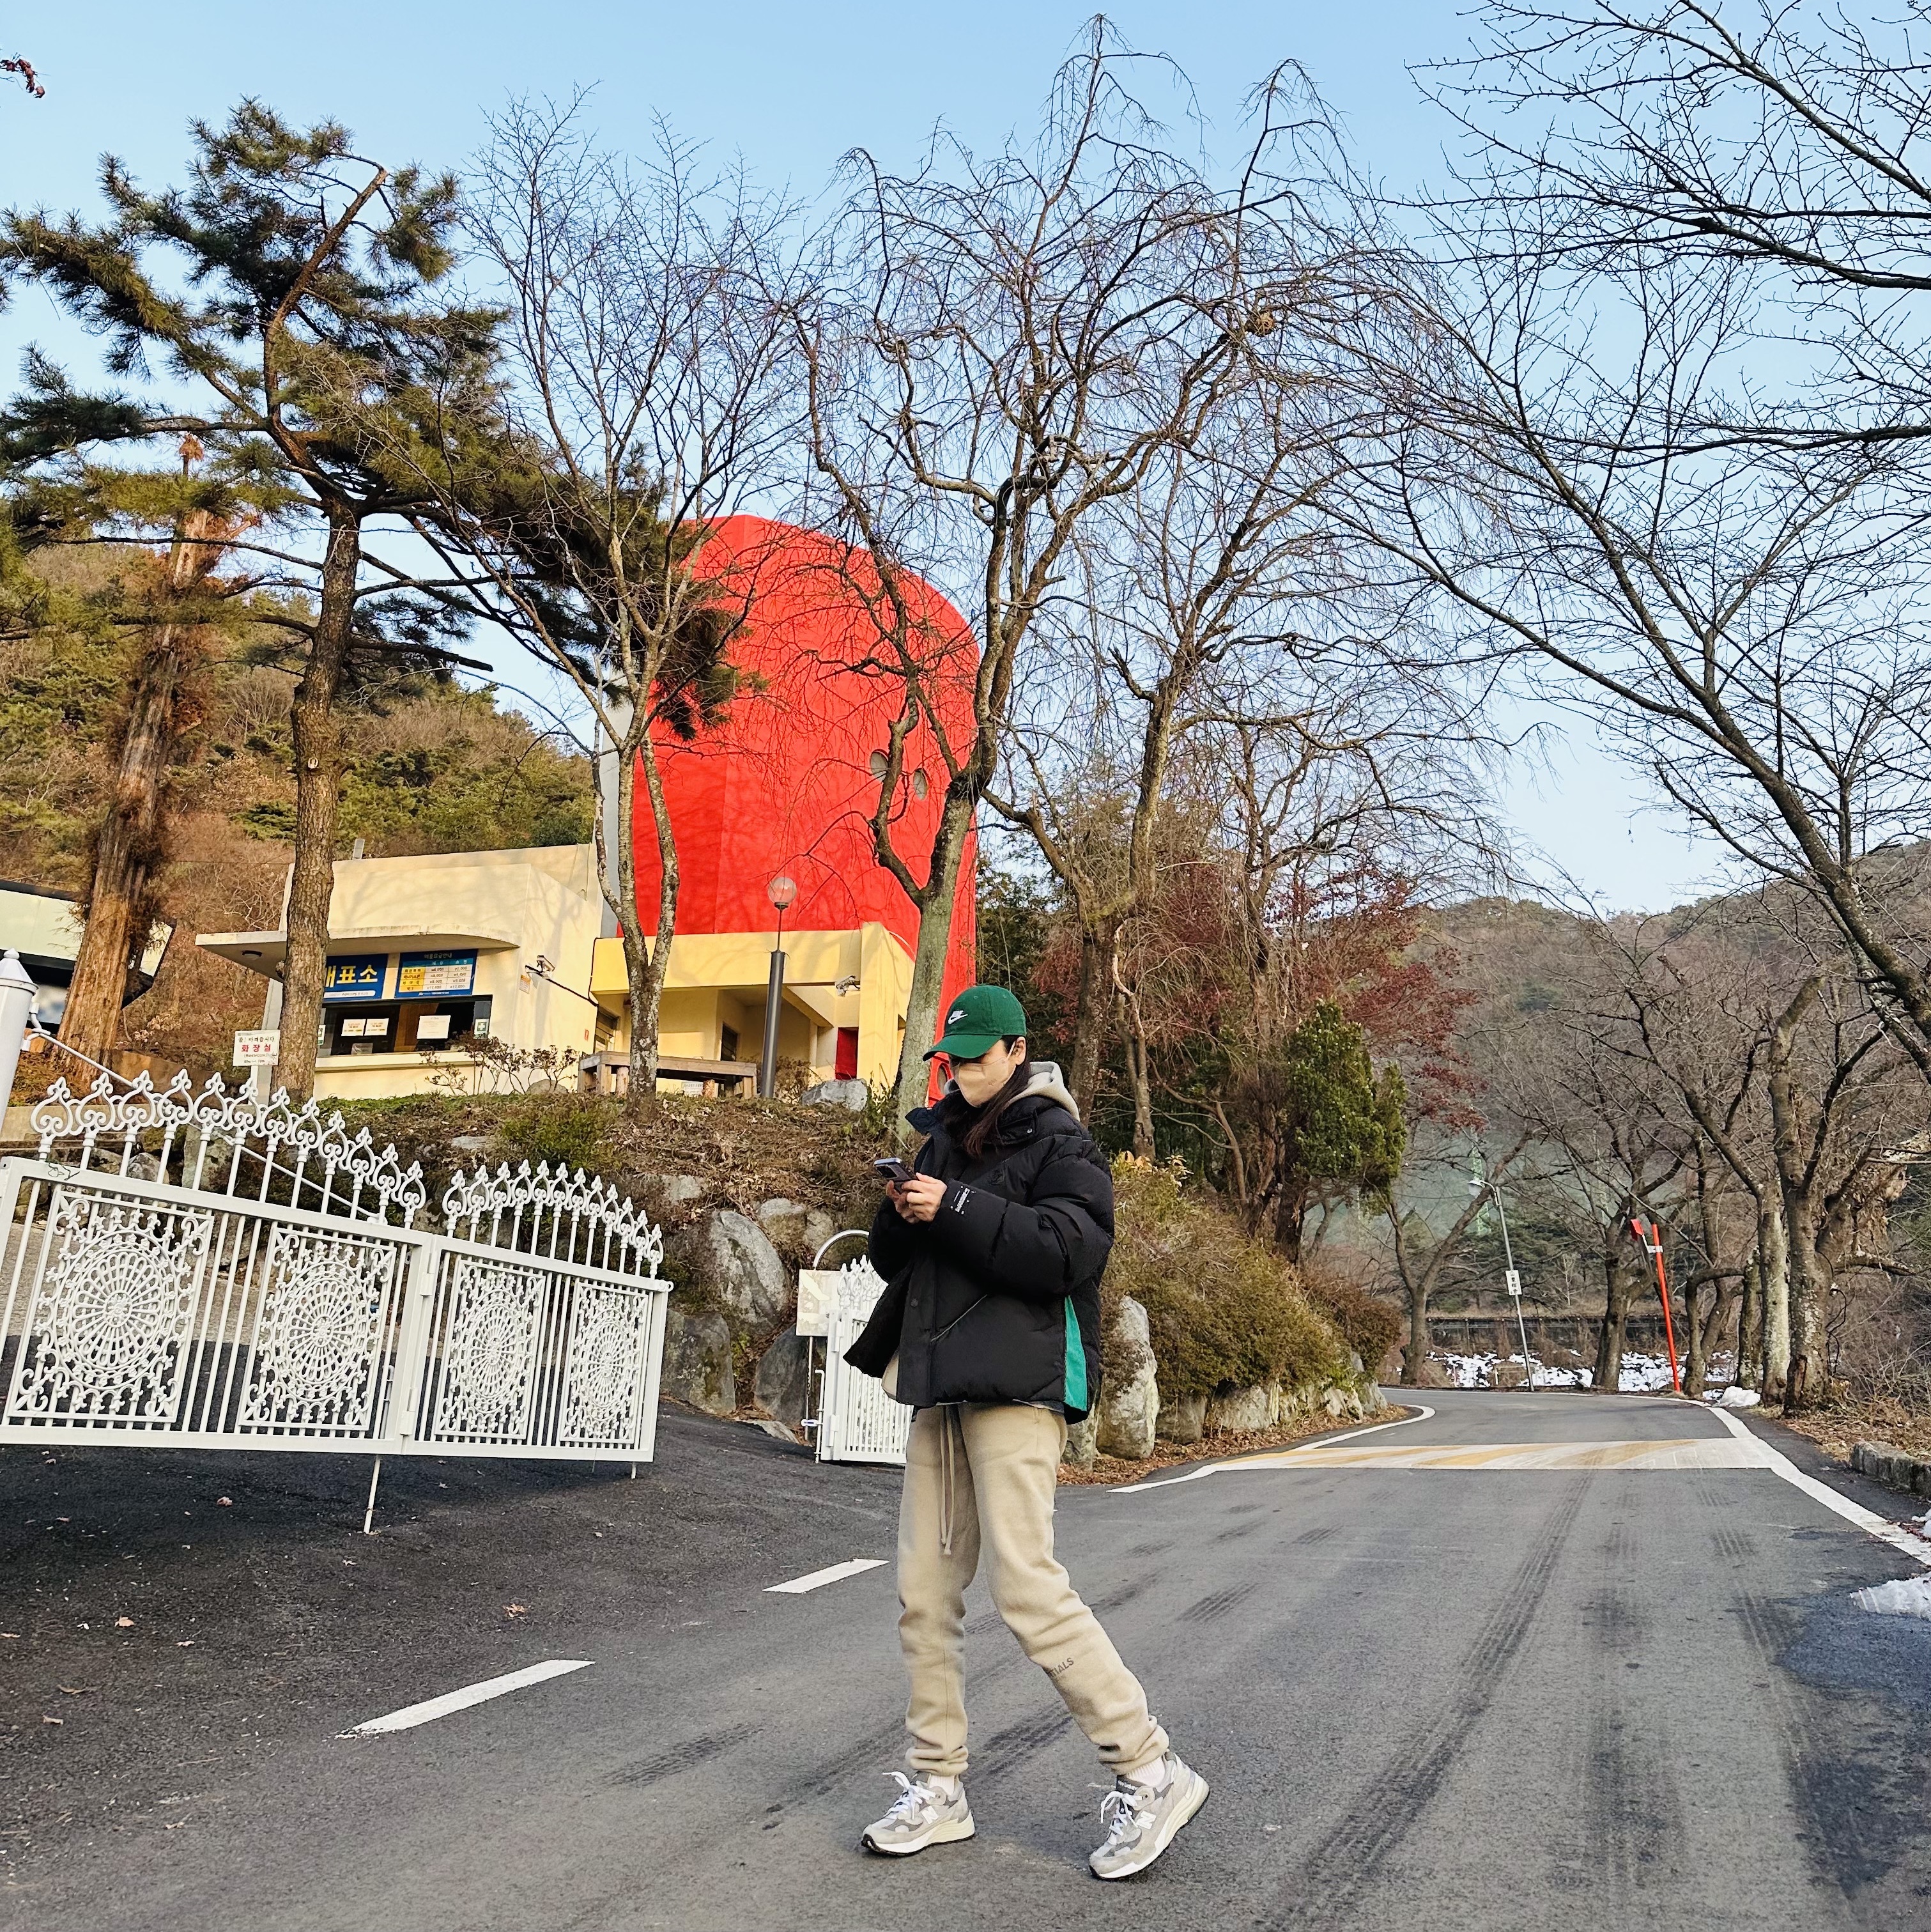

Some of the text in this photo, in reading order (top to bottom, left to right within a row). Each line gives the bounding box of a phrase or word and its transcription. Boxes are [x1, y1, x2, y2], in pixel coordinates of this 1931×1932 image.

[242, 1044, 272, 1053] 화장실
[1048, 1657, 1074, 1678] TIALS
[921, 1805, 939, 1825] N
[1136, 1811, 1157, 1830] N
